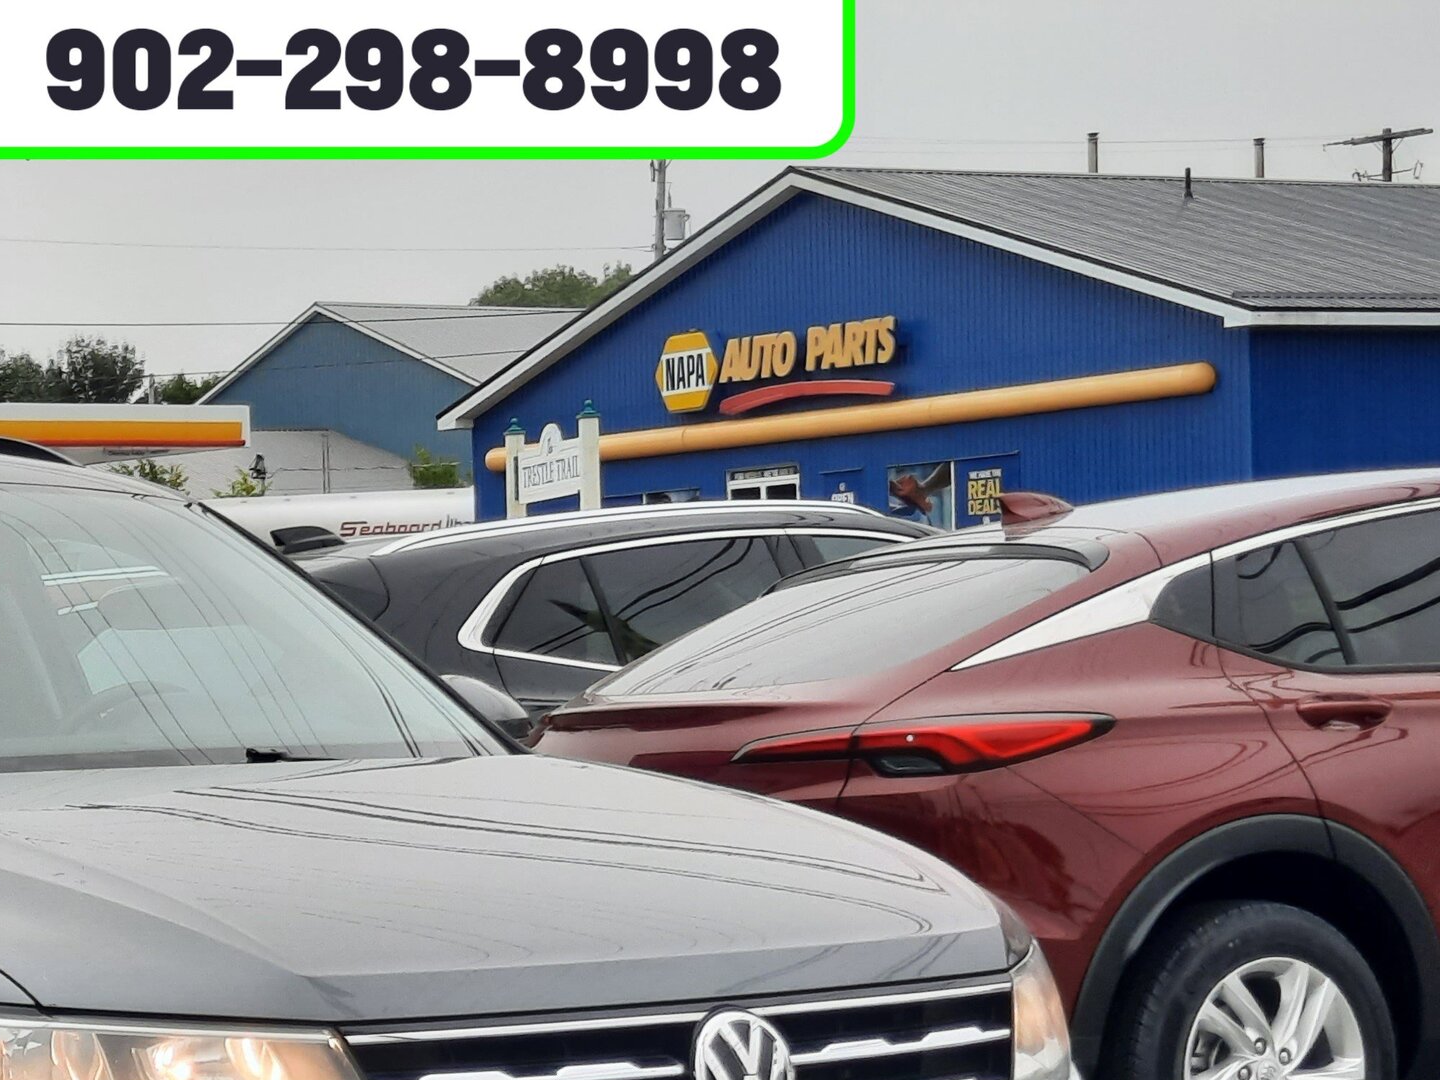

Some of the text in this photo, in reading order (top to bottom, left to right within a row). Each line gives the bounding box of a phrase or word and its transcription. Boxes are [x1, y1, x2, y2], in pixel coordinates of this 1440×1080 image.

[665, 315, 895, 391] NAPA AUTO PARTS
[968, 478, 1001, 500] REAL
[340, 519, 442, 537] Seaboard
